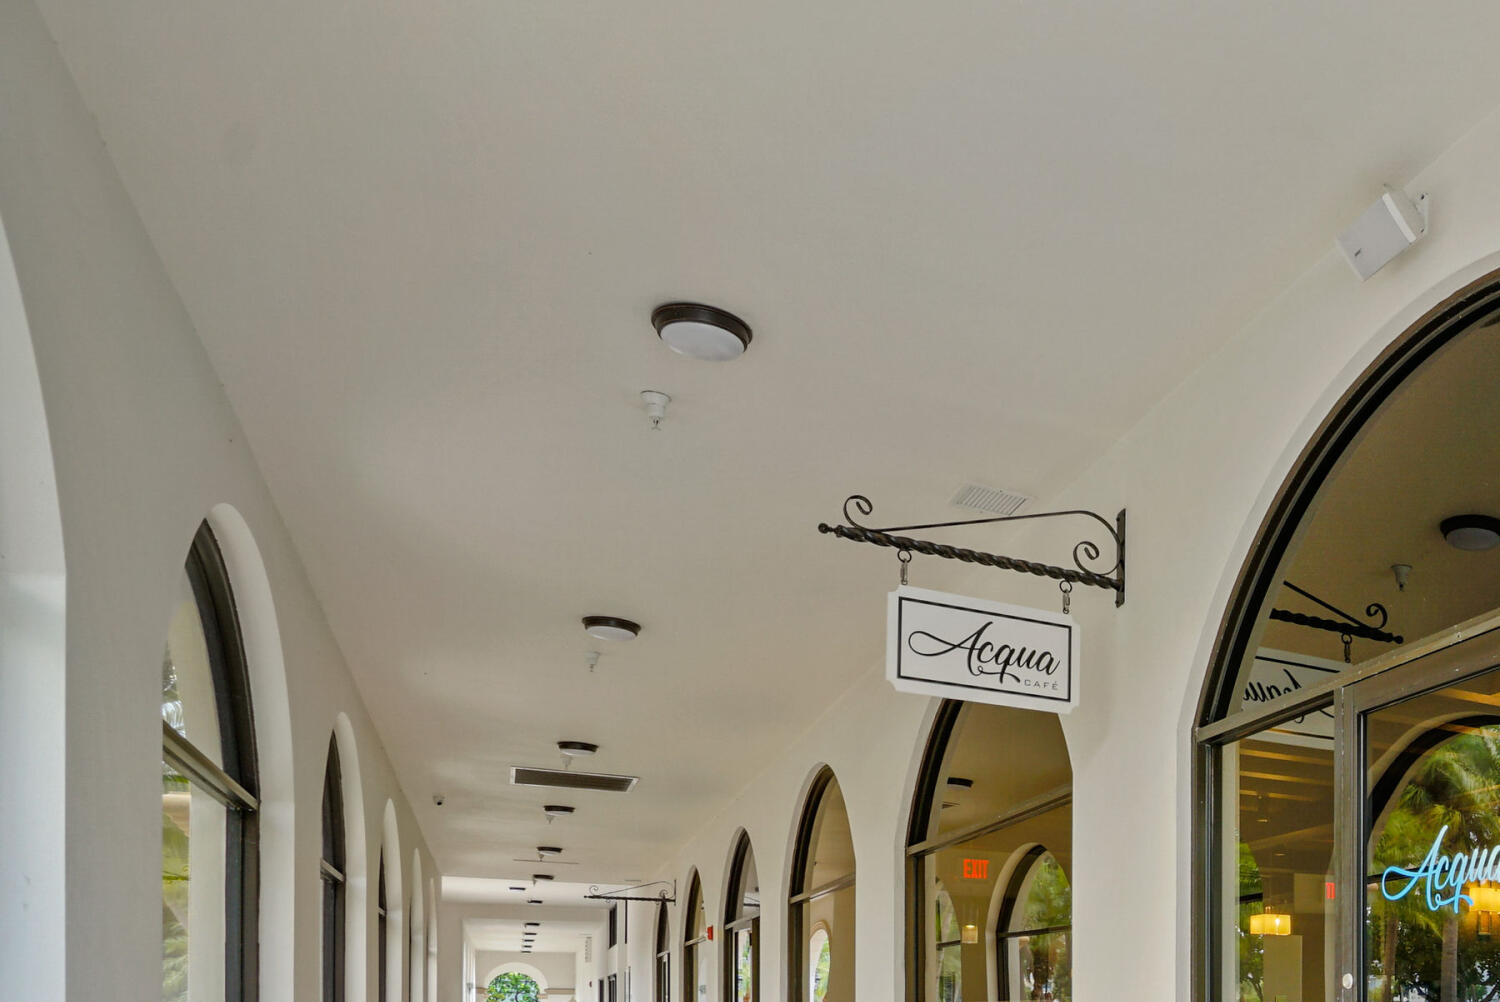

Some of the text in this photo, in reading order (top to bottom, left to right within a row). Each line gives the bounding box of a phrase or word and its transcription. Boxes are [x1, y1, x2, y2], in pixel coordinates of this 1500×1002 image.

[908, 621, 1060, 683] Acqua
[1023, 677, 1059, 691] CAFÉ
[963, 859, 989, 879] EXIT
